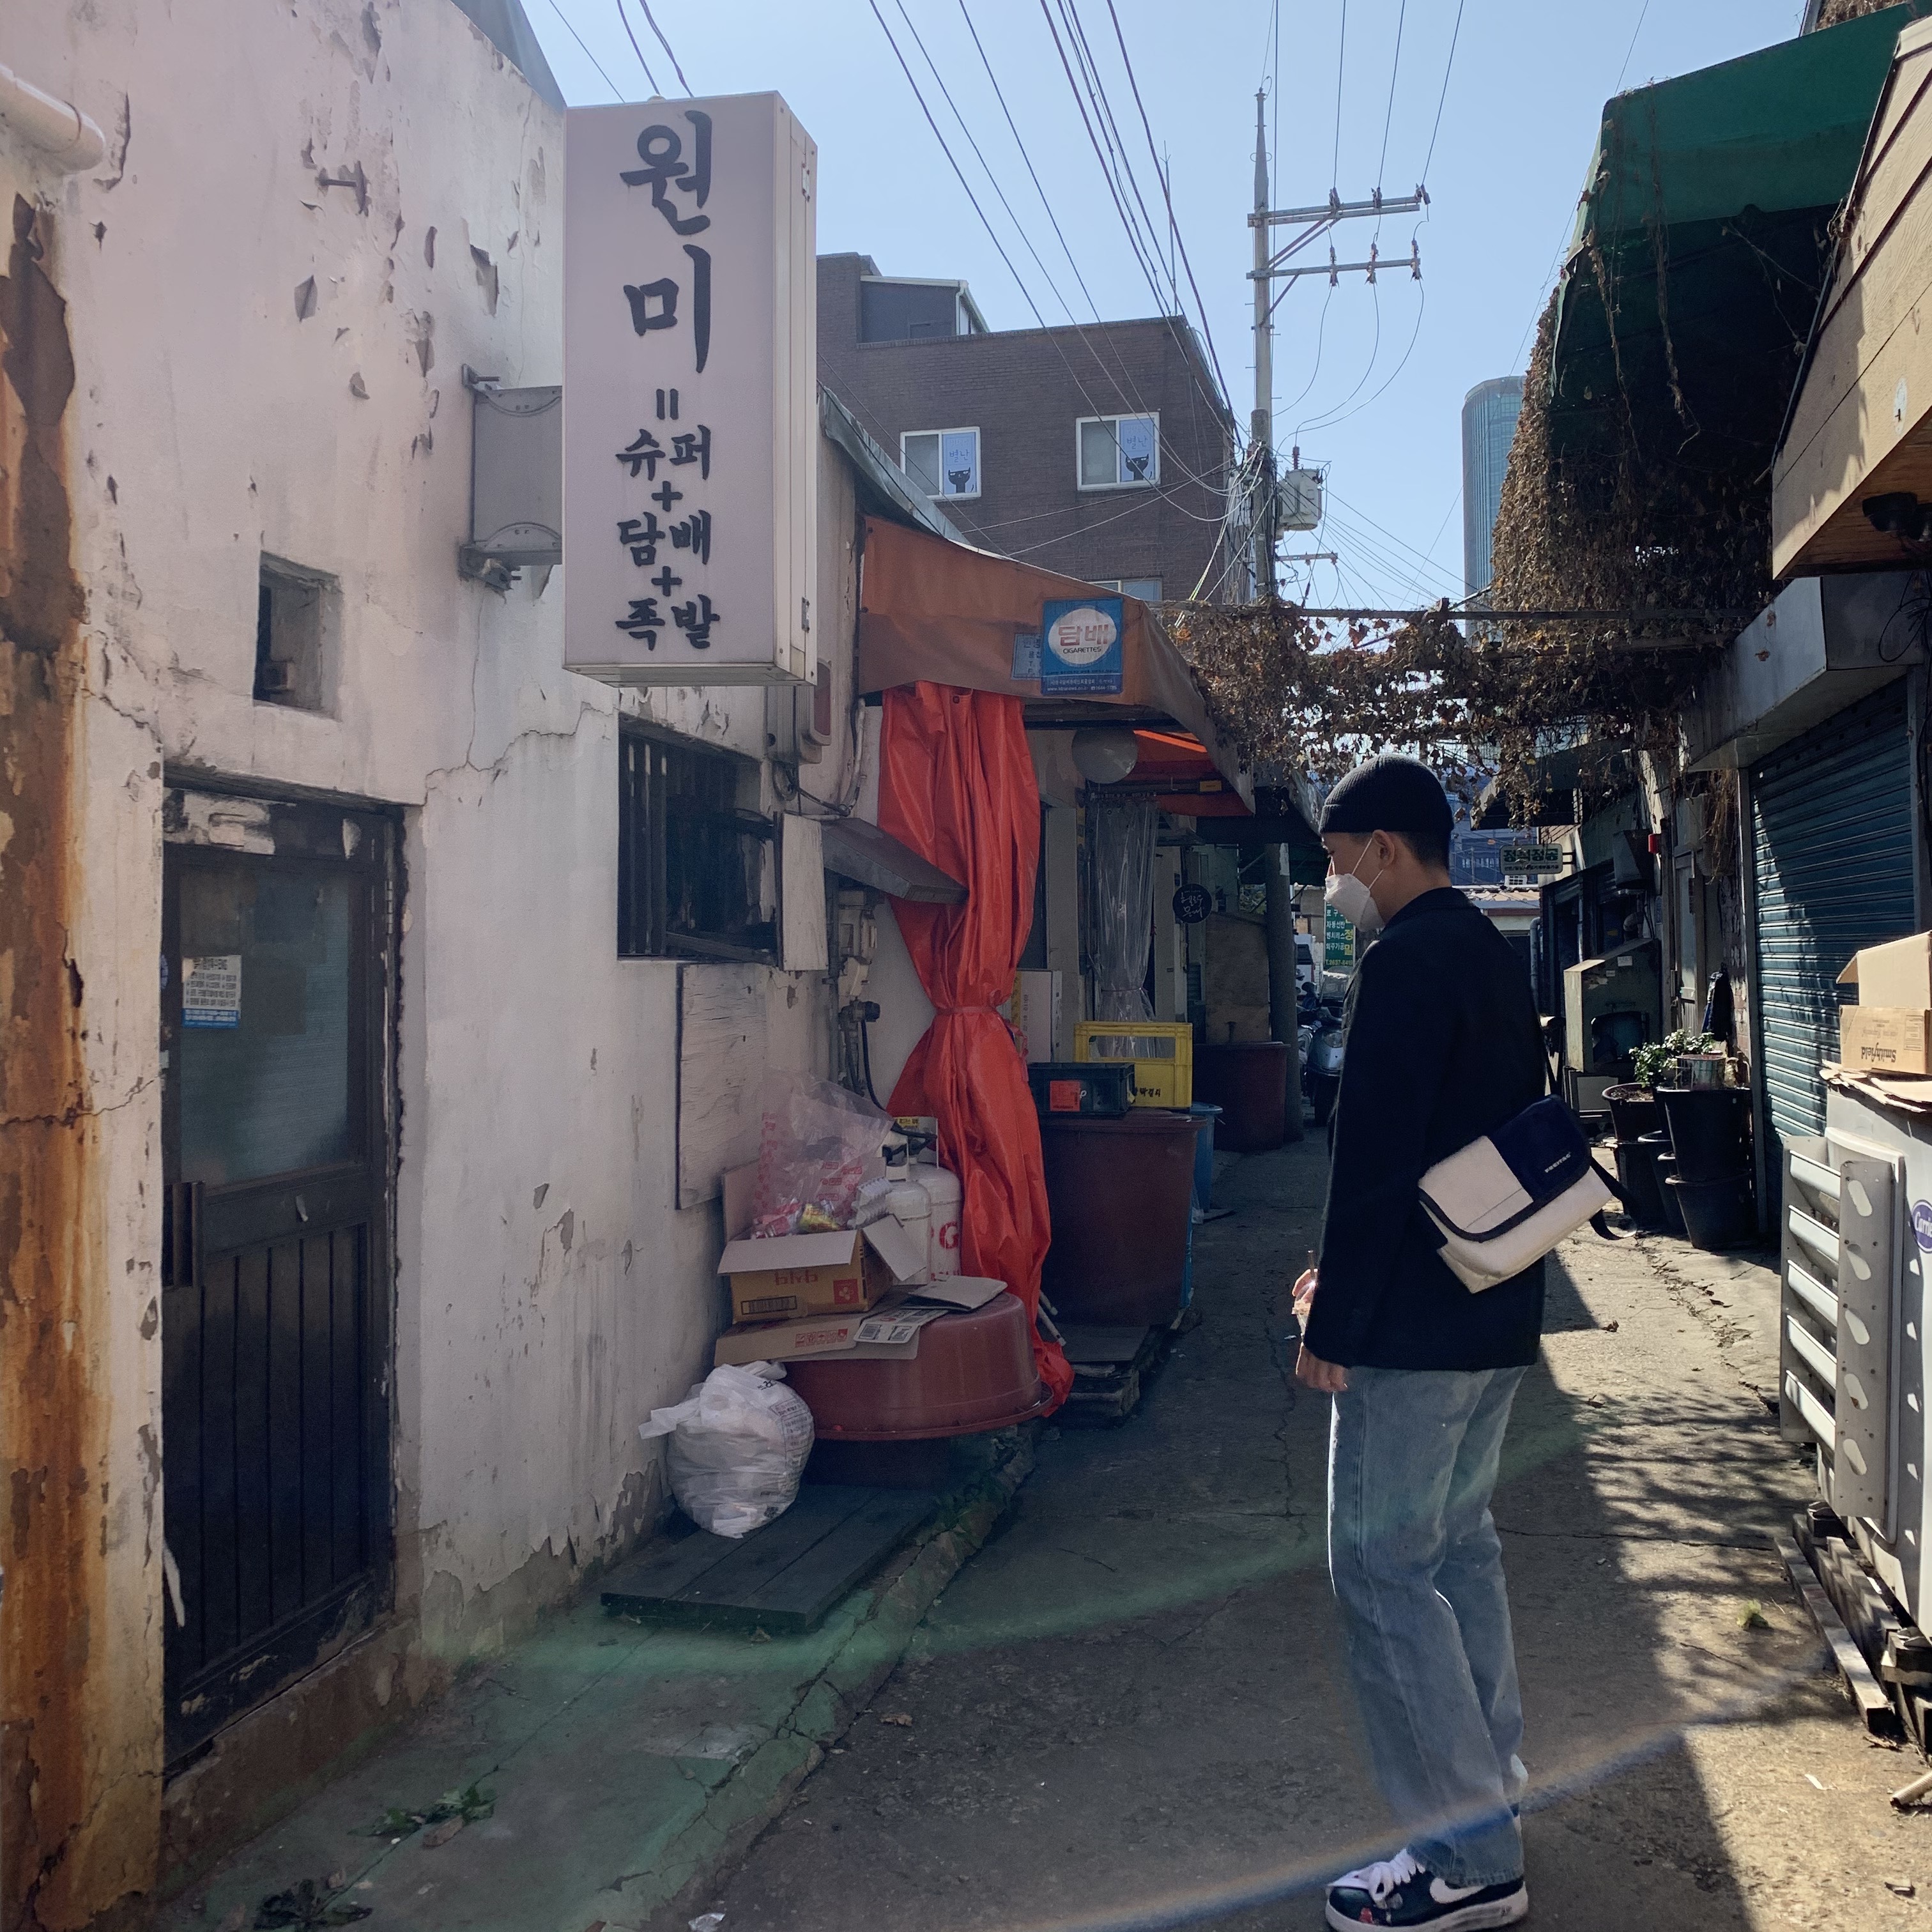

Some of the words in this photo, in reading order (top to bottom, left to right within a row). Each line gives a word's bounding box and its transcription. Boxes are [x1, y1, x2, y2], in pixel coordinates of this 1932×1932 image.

[619, 109, 713, 374] 원미
[615, 424, 712, 480] 슈퍼
[949, 449, 970, 463] 별난
[617, 510, 711, 566] 담배
[615, 594, 720, 651] 족발
[1058, 624, 1109, 647] 담배
[1861, 1043, 1897, 1063] Smithfield
